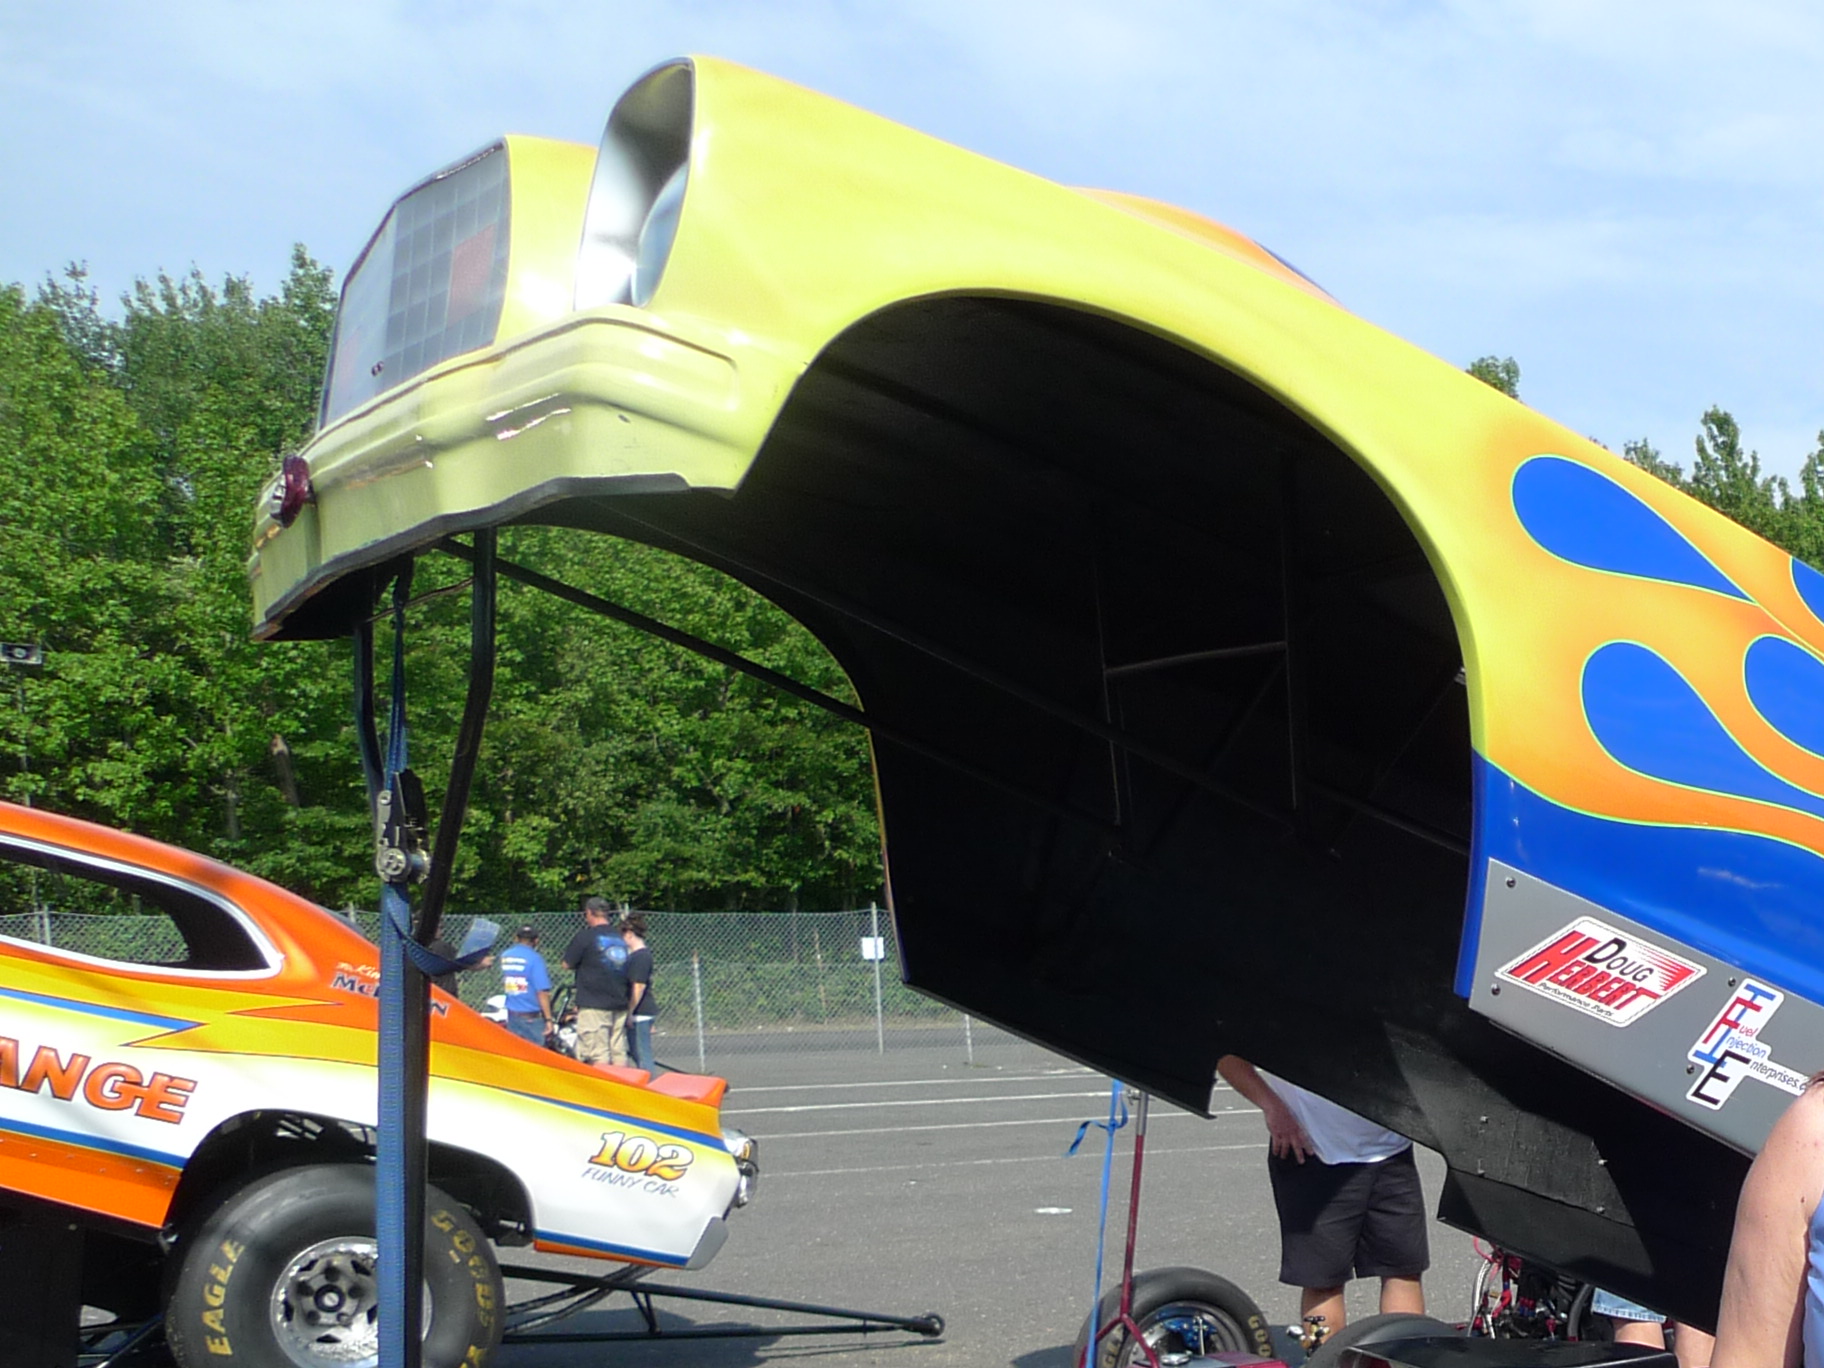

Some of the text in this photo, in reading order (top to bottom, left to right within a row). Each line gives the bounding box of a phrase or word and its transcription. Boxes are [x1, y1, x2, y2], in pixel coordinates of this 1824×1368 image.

[1508, 930, 1662, 1010] HERBERT
[1583, 937, 1654, 983] DOUG
[588, 1131, 694, 1181] 102
[581, 1167, 679, 1198] FUNNY CAR
[202, 1239, 245, 1356] EAGLE
